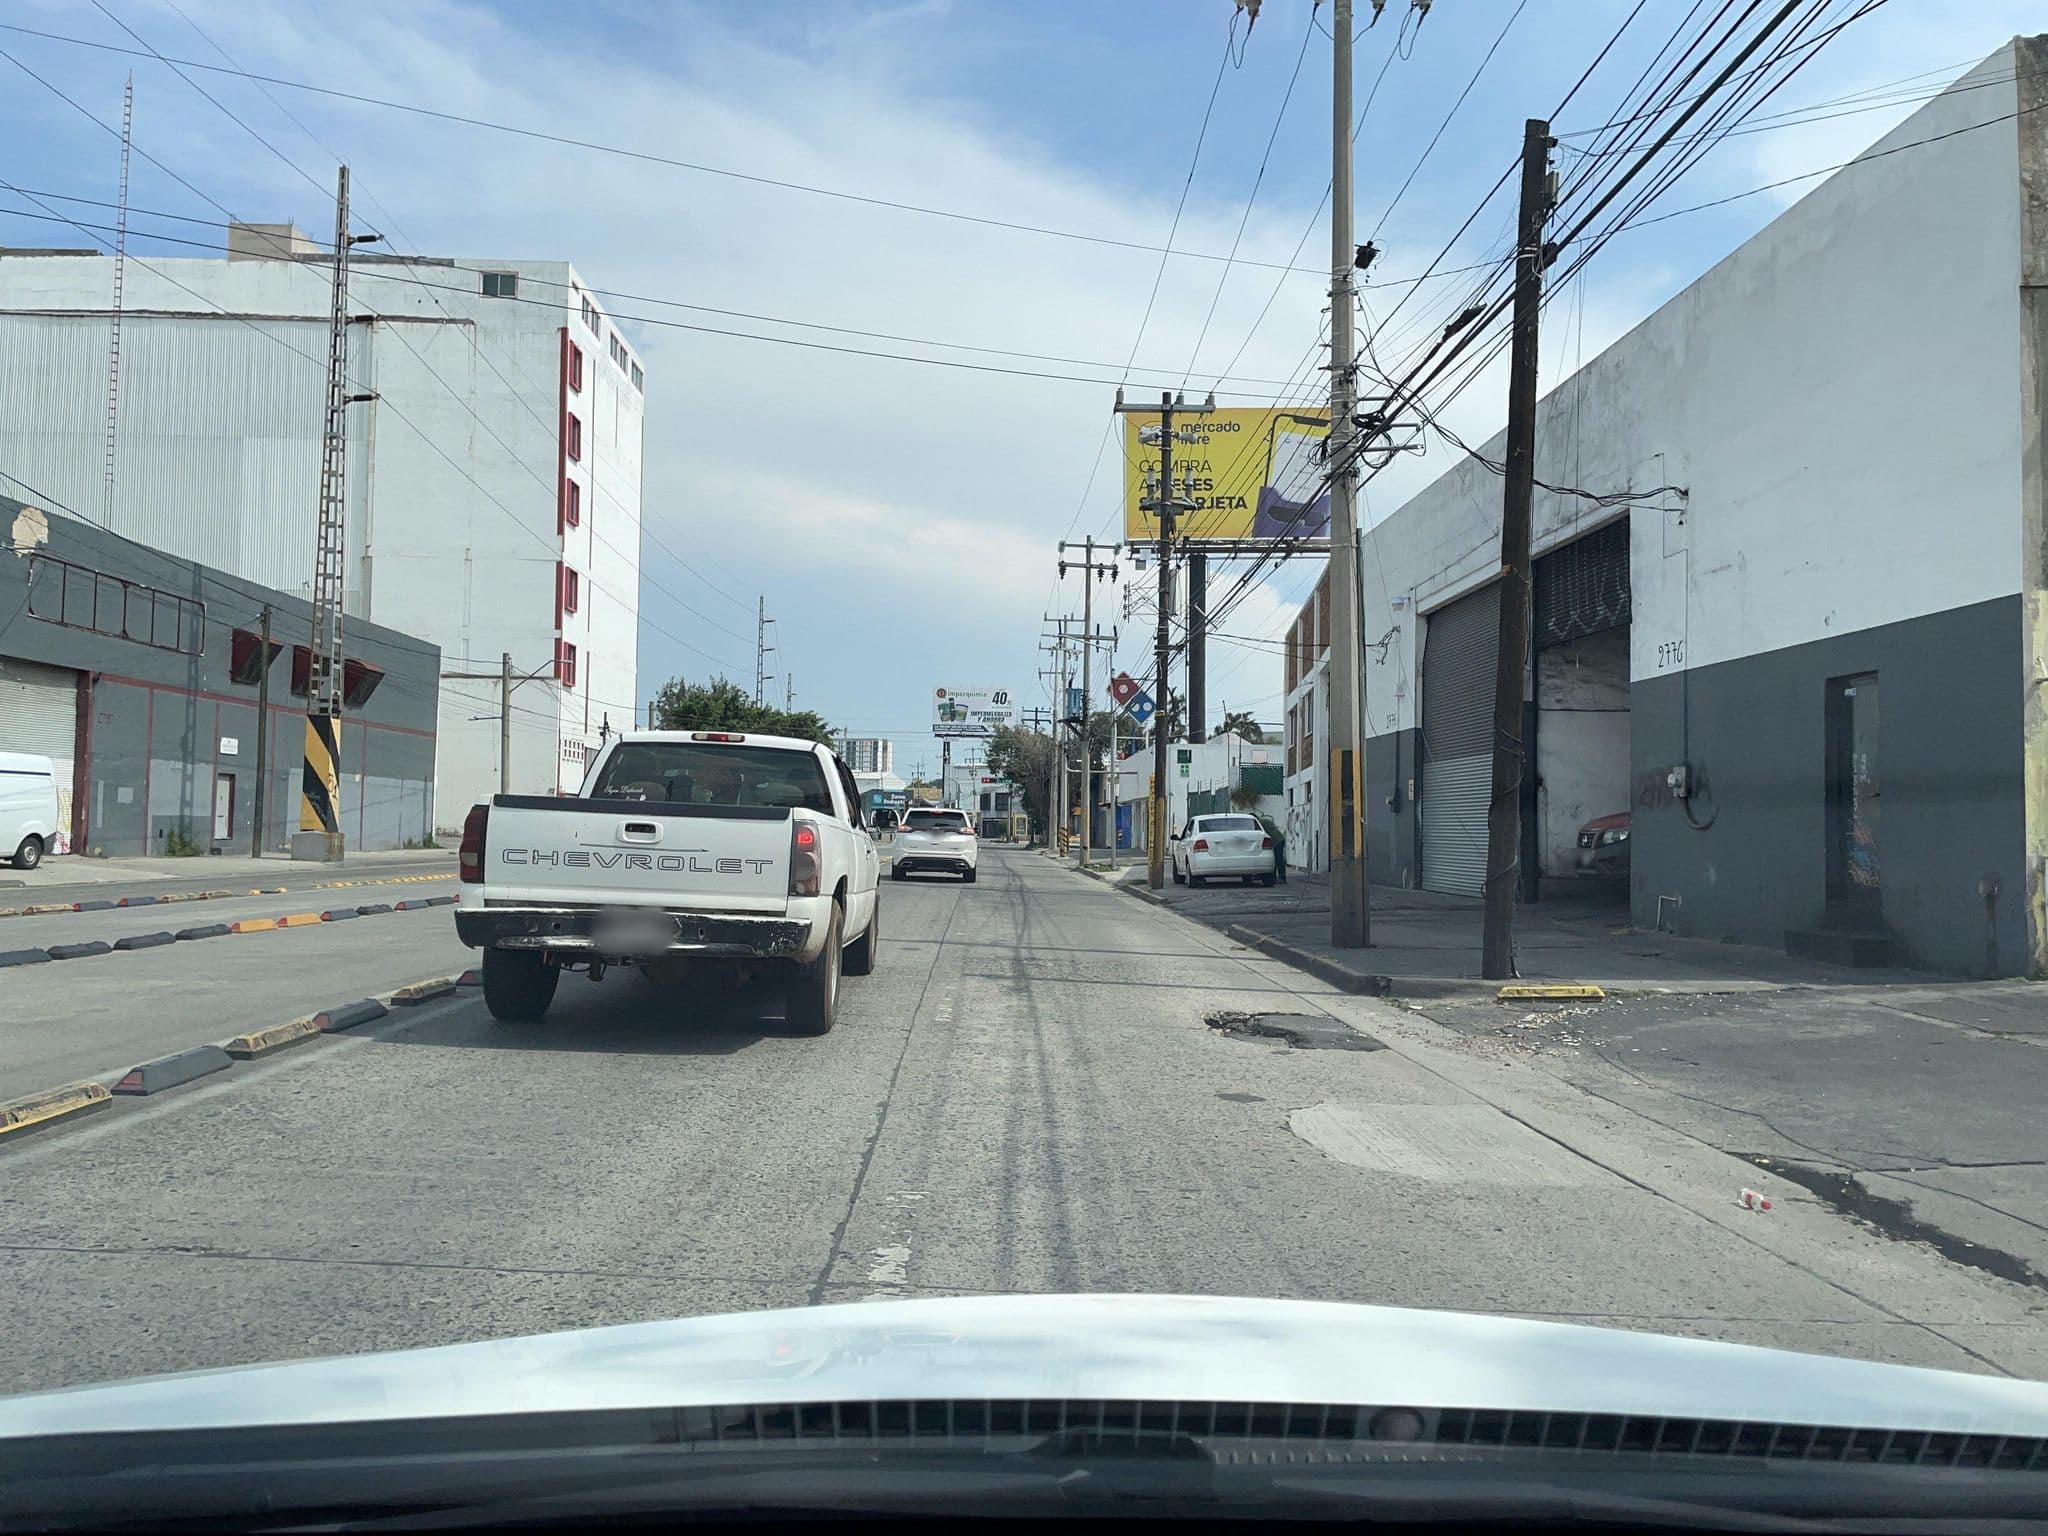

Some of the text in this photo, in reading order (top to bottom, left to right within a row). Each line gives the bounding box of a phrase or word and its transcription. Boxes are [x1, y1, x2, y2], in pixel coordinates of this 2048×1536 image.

[1181, 421, 1240, 433] mercado
[1658, 640, 1683, 669] 2776
[502, 848, 773, 874] CHEVROLET
